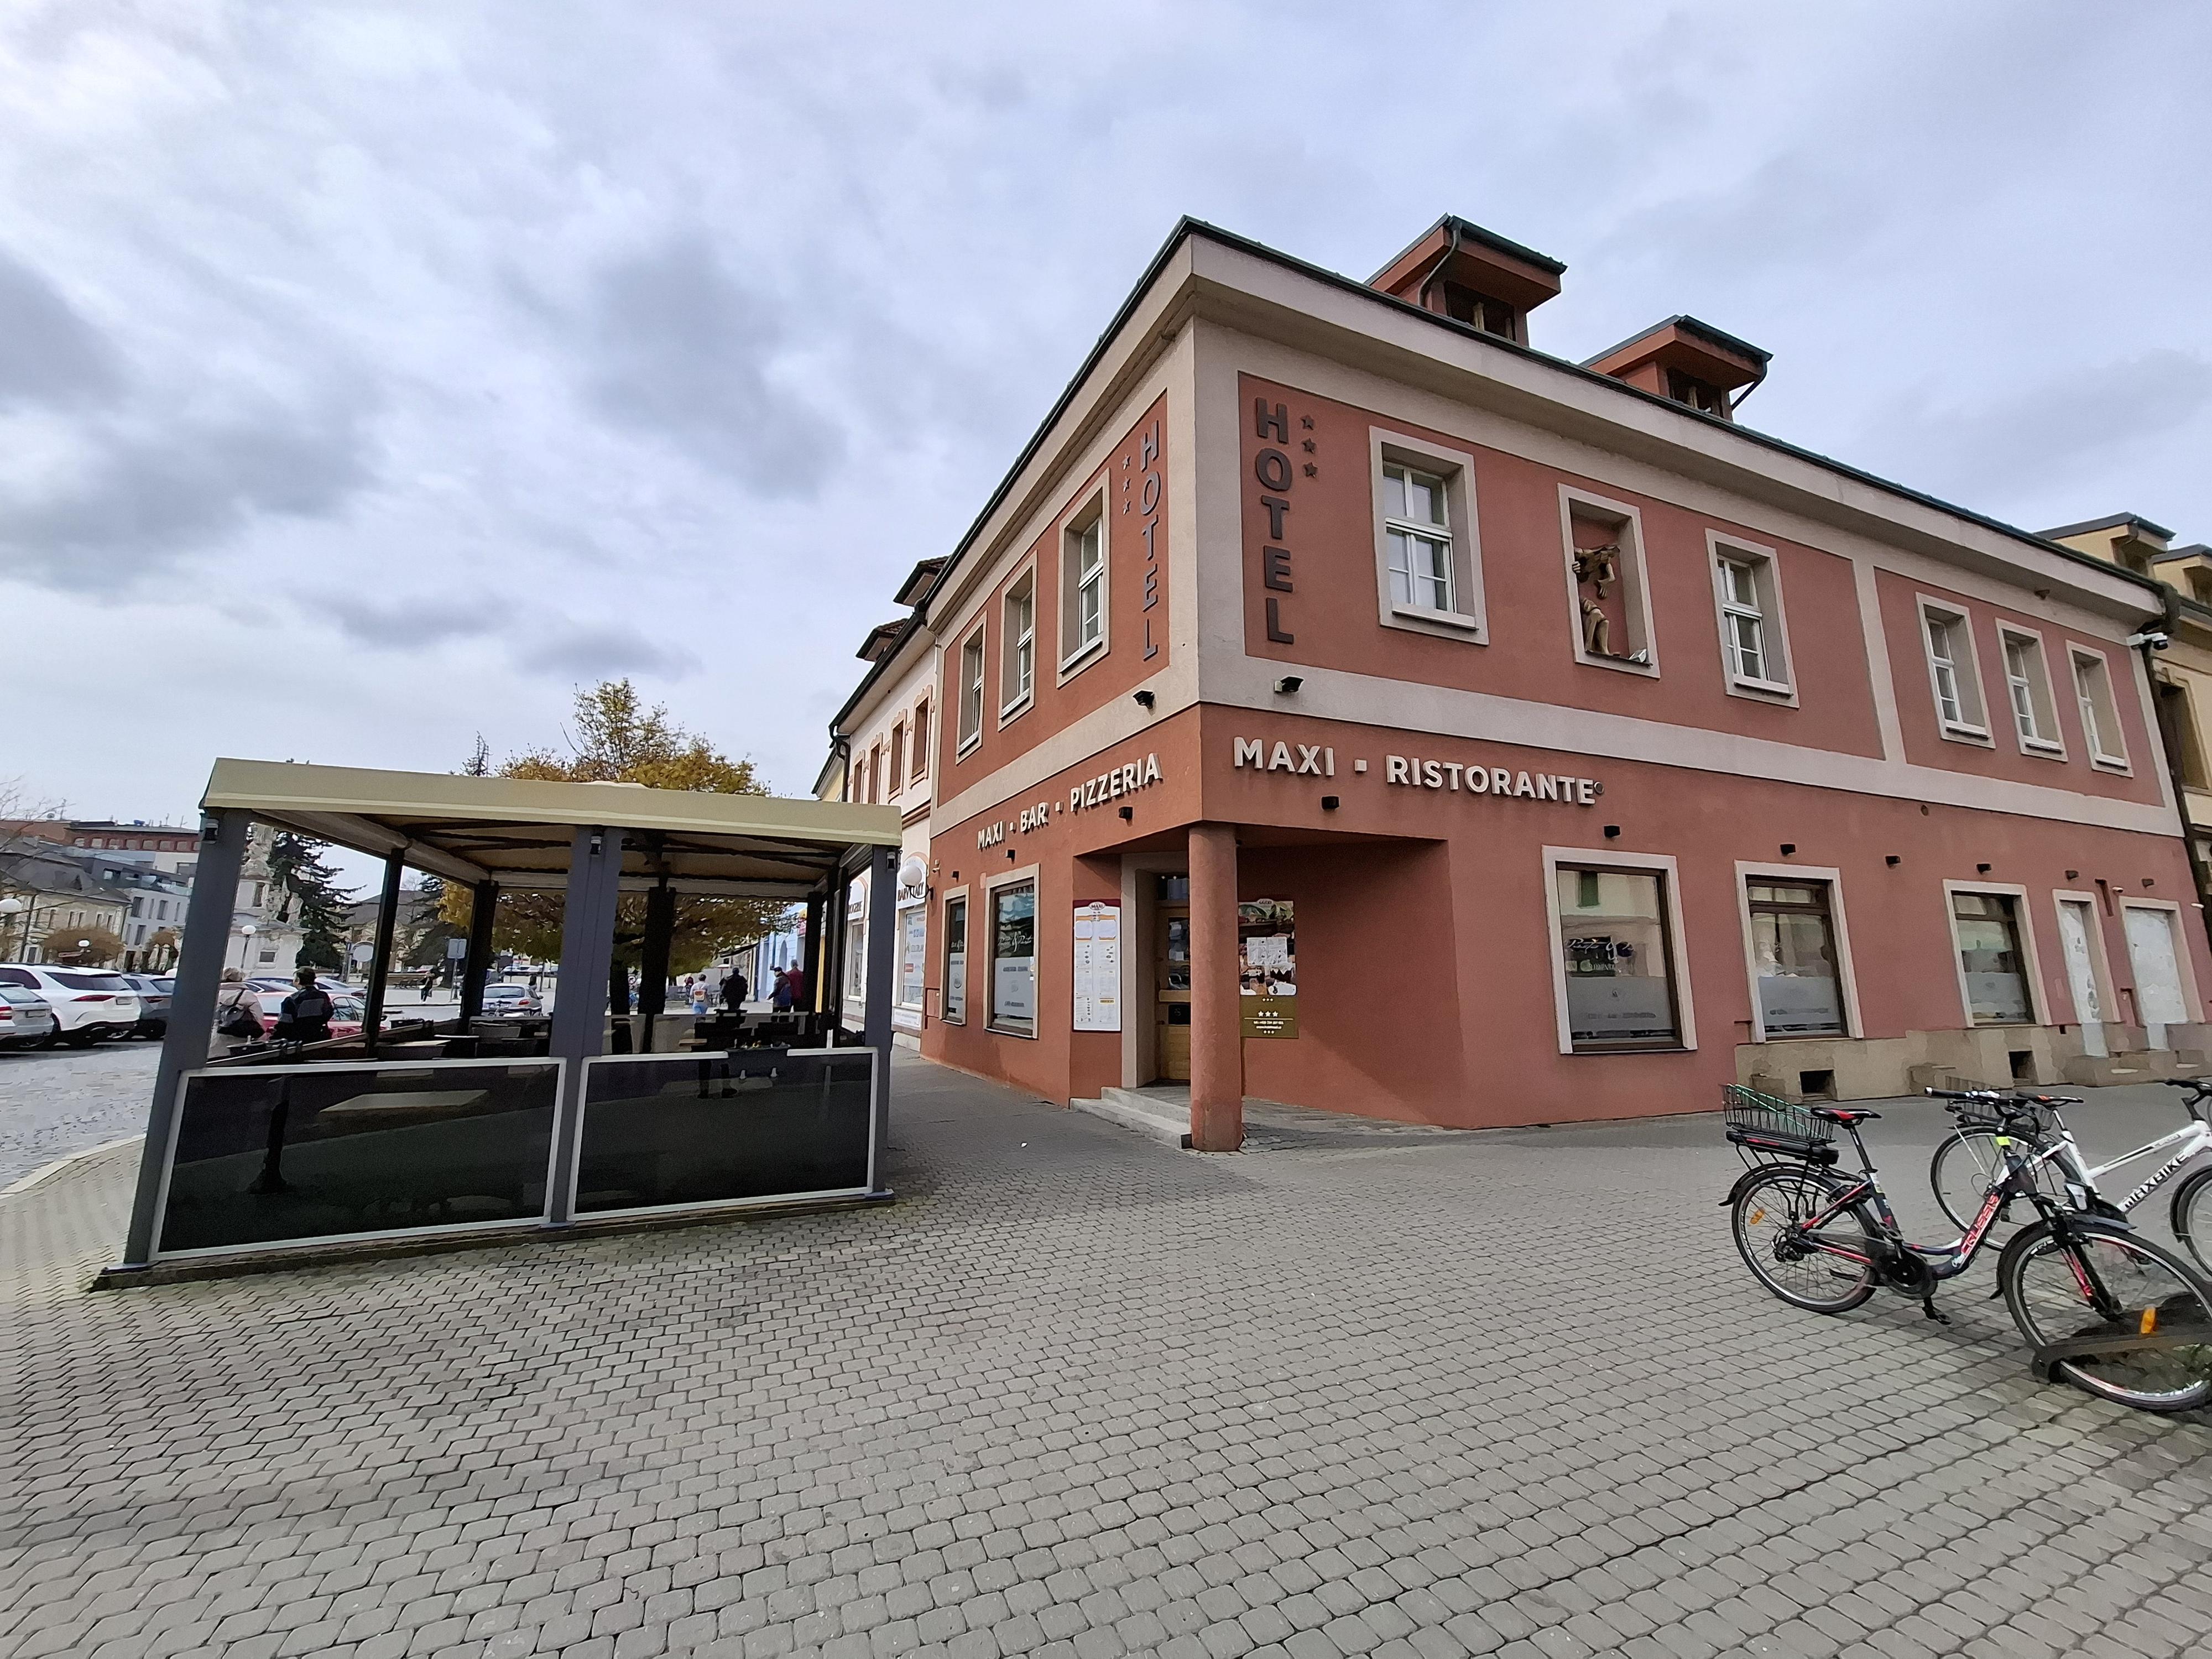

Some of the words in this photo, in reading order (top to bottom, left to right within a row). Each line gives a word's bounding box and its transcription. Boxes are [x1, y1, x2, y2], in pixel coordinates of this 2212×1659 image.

[1140, 419, 1161, 662] HOTEL
[1255, 397, 1294, 645] HOTEL
[977, 820, 1005, 849] MAXI
[1020, 801, 1049, 833] BAR
[1070, 753, 1163, 813] PIZZERIA
[1233, 736, 1335, 776] MAXI
[1386, 754, 1596, 805] RISTORANTE
[2125, 1154, 2189, 1208] MAXBIKE
